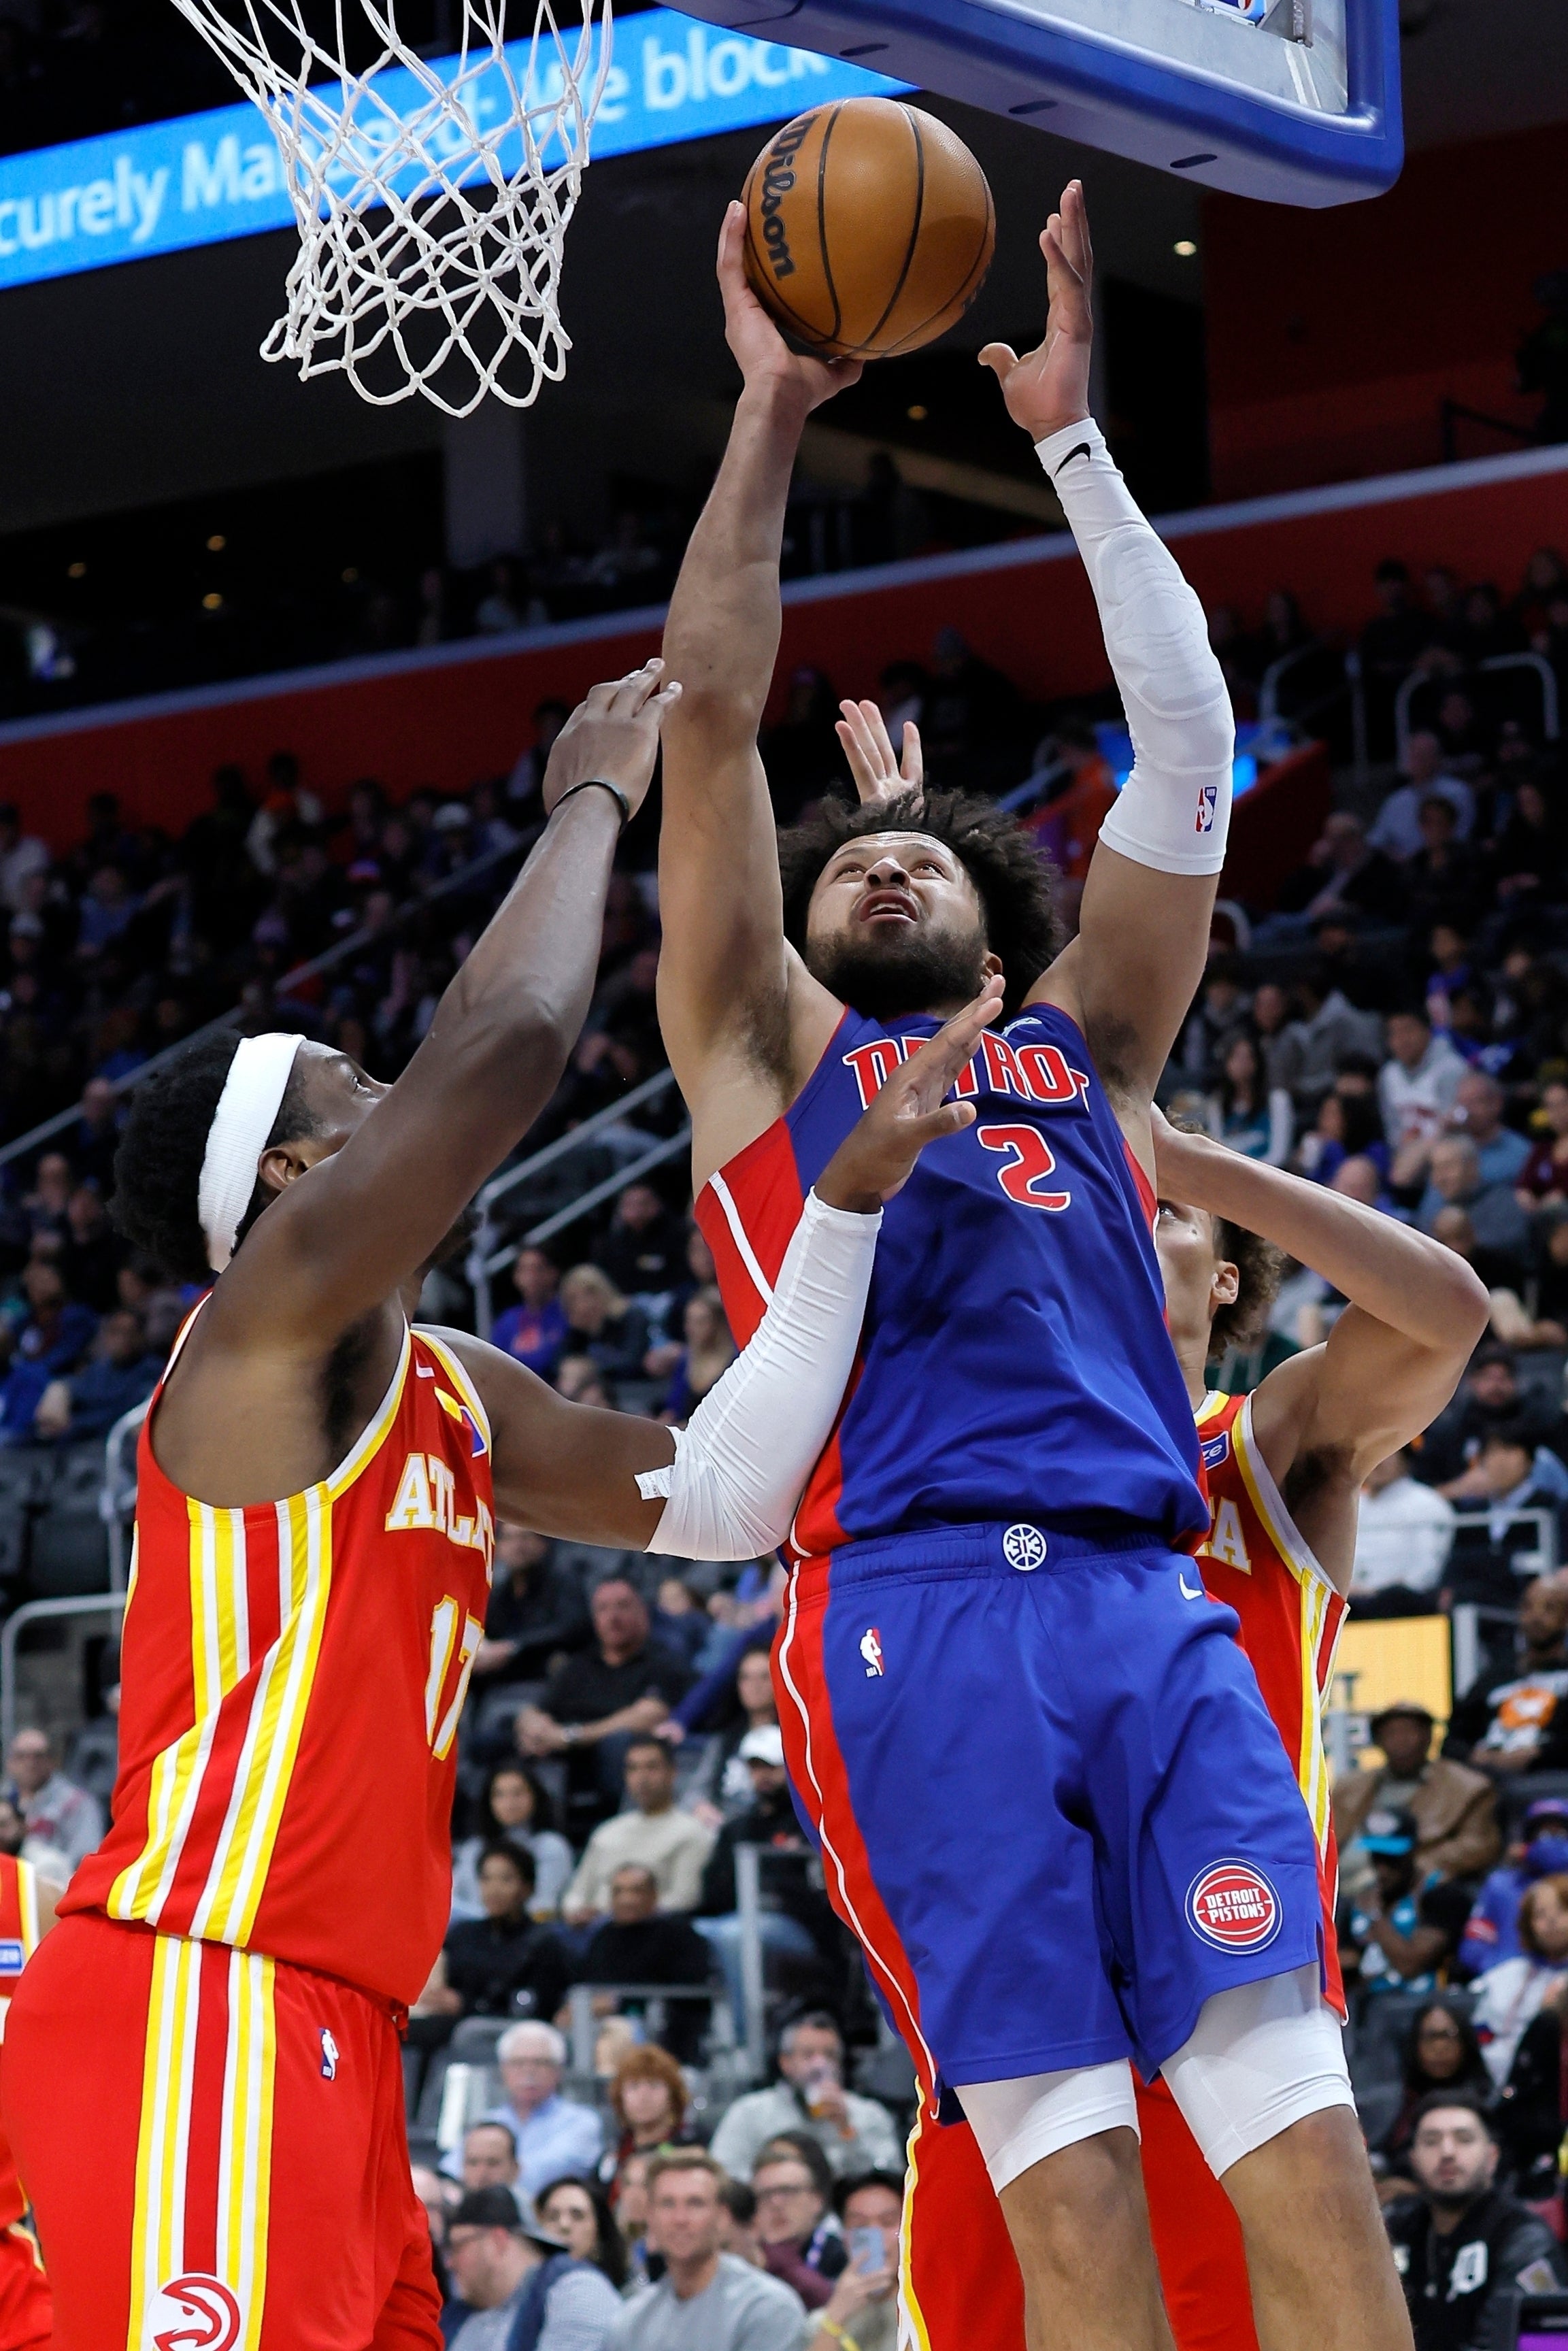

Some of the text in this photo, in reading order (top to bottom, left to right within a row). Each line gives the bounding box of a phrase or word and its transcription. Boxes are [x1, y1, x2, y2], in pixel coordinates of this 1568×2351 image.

[761, 114, 821, 281] Wilson
[977, 1123, 1071, 1212] 2
[1203, 1888, 1261, 1910] DETROIT
[1207, 1902, 1266, 1924] PISTONS
